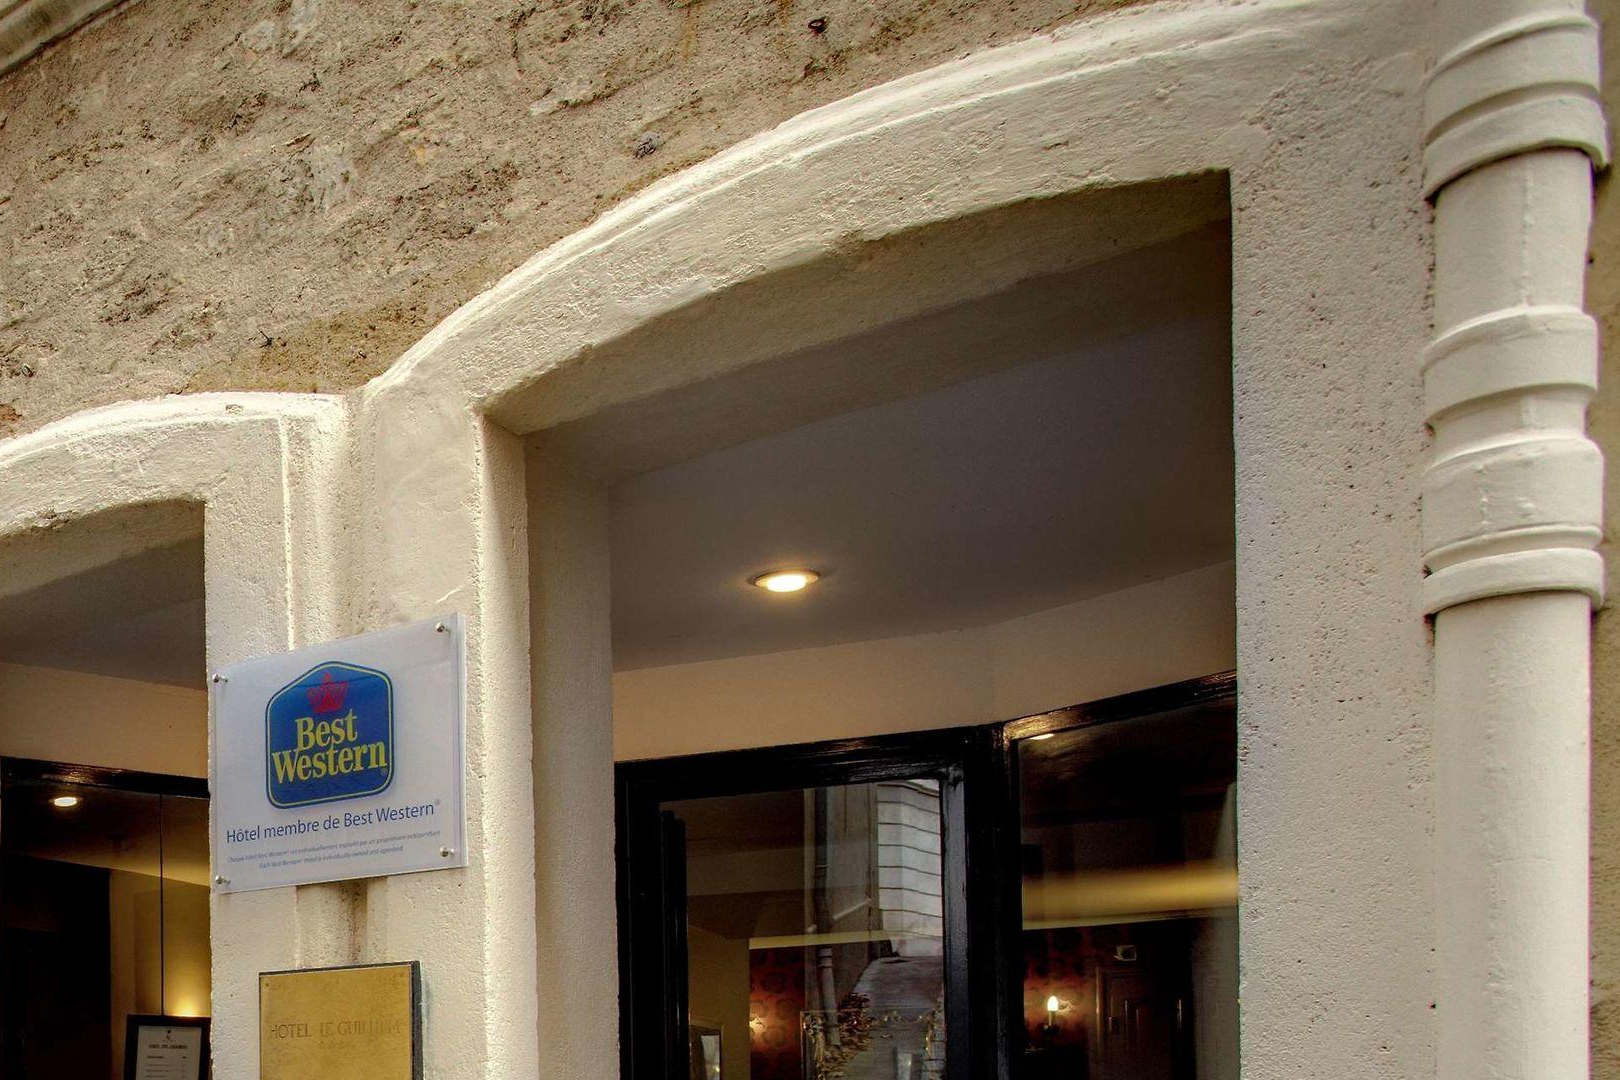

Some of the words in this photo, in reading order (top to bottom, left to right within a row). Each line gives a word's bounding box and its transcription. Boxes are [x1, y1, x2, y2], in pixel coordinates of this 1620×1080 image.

[295, 708, 358, 752] Best
[272, 740, 388, 785] Western
[226, 824, 261, 844] Hôtel
[263, 817, 320, 839] membre
[323, 814, 341, 831] de
[343, 810, 374, 828] Best
[375, 802, 435, 823] Western
[269, 1023, 311, 1040] HOTEL
